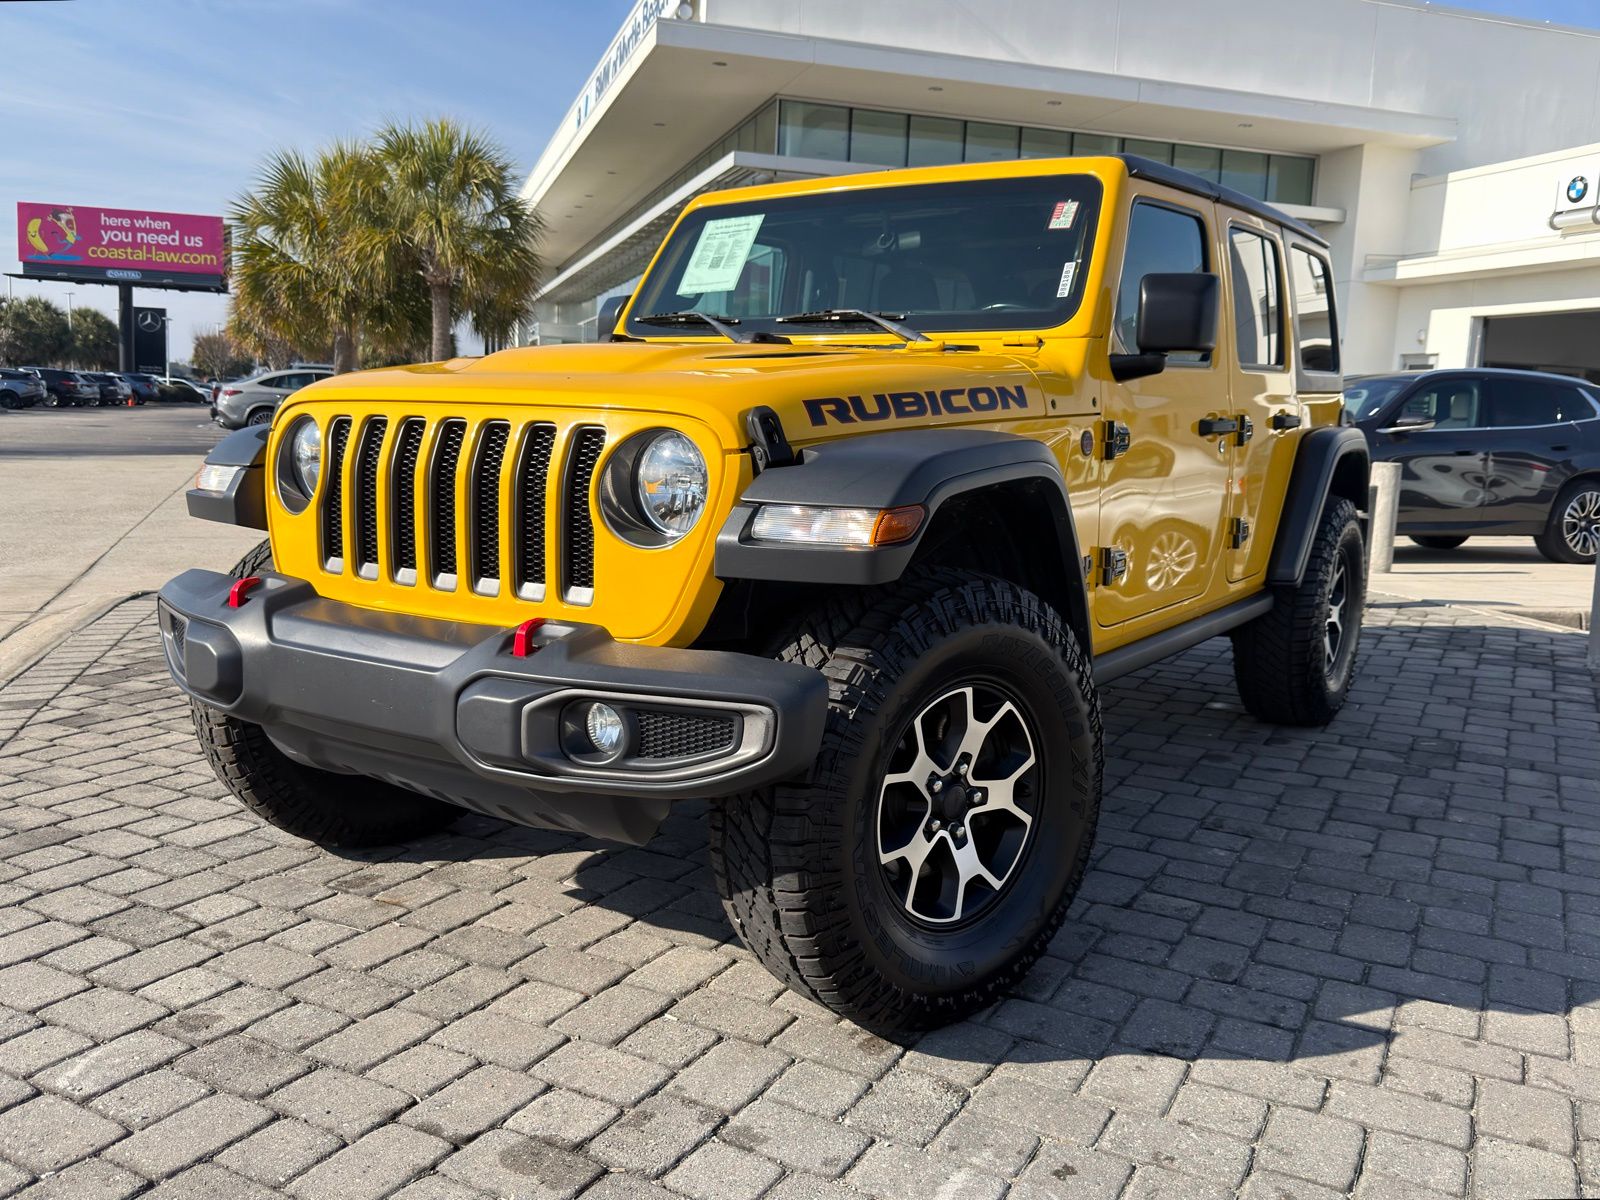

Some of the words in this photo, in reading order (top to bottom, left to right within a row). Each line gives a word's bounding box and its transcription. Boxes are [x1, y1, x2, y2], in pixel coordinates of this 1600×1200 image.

[642, 0, 669, 35] Beac
[100, 213, 131, 228] here
[134, 216, 171, 230] when
[100, 229, 132, 245] you
[137, 231, 180, 246] need
[184, 235, 203, 247] us
[88, 246, 218, 266] coastal-law.com
[801, 385, 1029, 427] RUBICON
